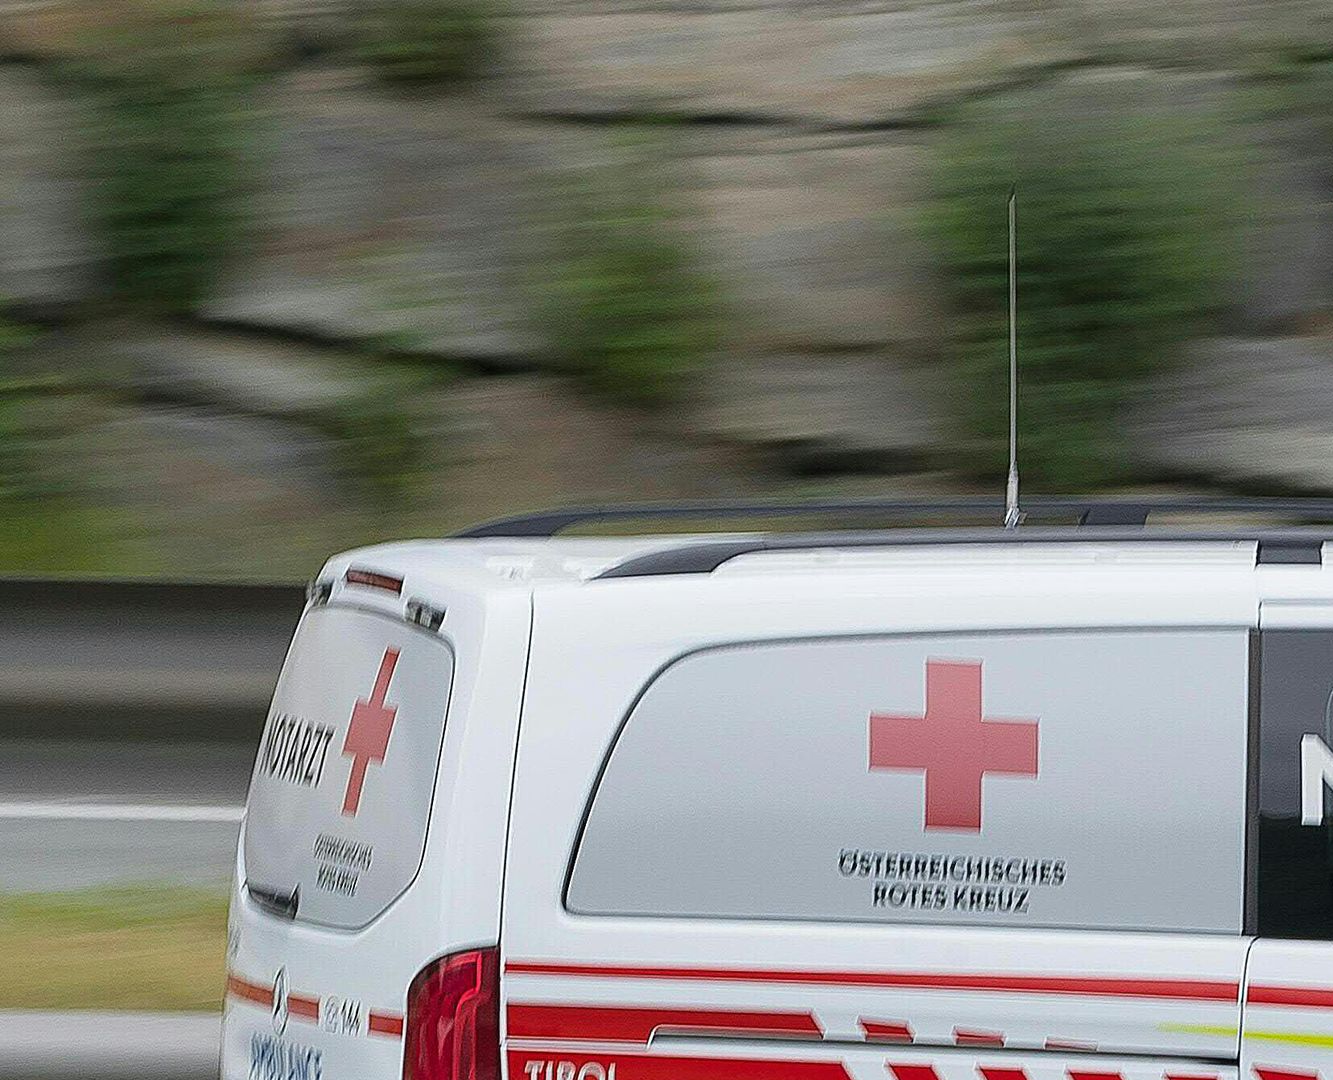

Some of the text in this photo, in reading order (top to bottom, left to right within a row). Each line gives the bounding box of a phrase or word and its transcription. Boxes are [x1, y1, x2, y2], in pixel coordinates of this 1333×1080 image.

[260, 712, 336, 789] NOTARZT
[838, 848, 1067, 886] ÖSTERREICHISCHES
[872, 880, 1031, 914] ROTES KREUZ
